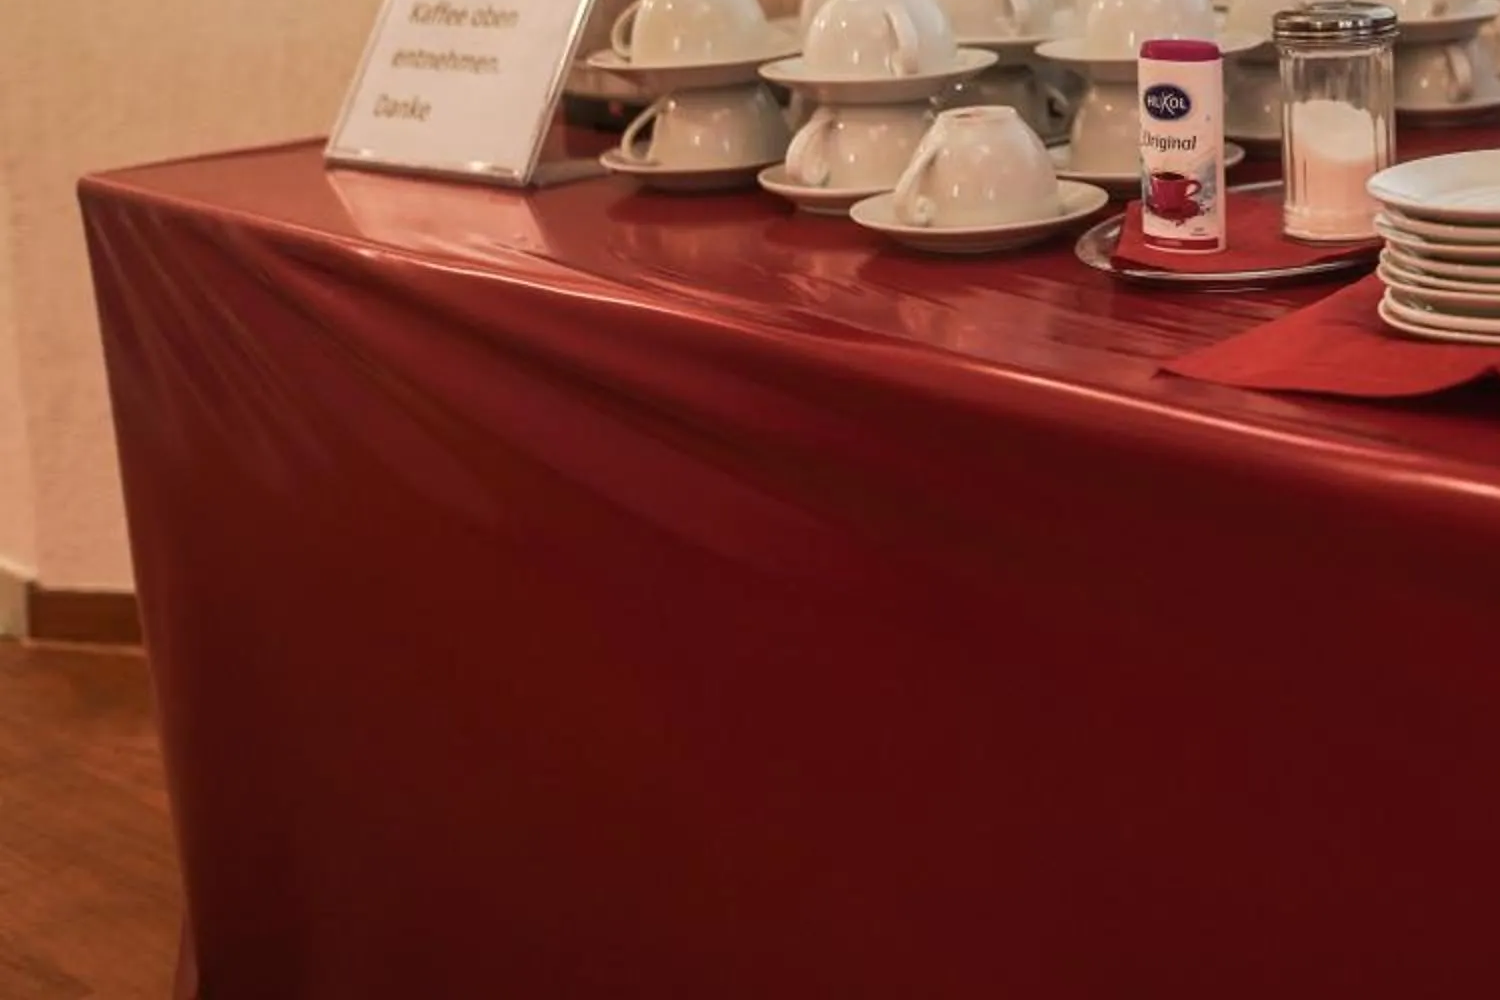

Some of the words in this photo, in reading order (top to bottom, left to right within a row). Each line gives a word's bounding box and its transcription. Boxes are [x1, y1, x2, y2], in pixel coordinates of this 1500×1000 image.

[408, 0, 469, 27] Kaffee
[470, 3, 519, 29] oben
[373, 93, 433, 122] Danke
